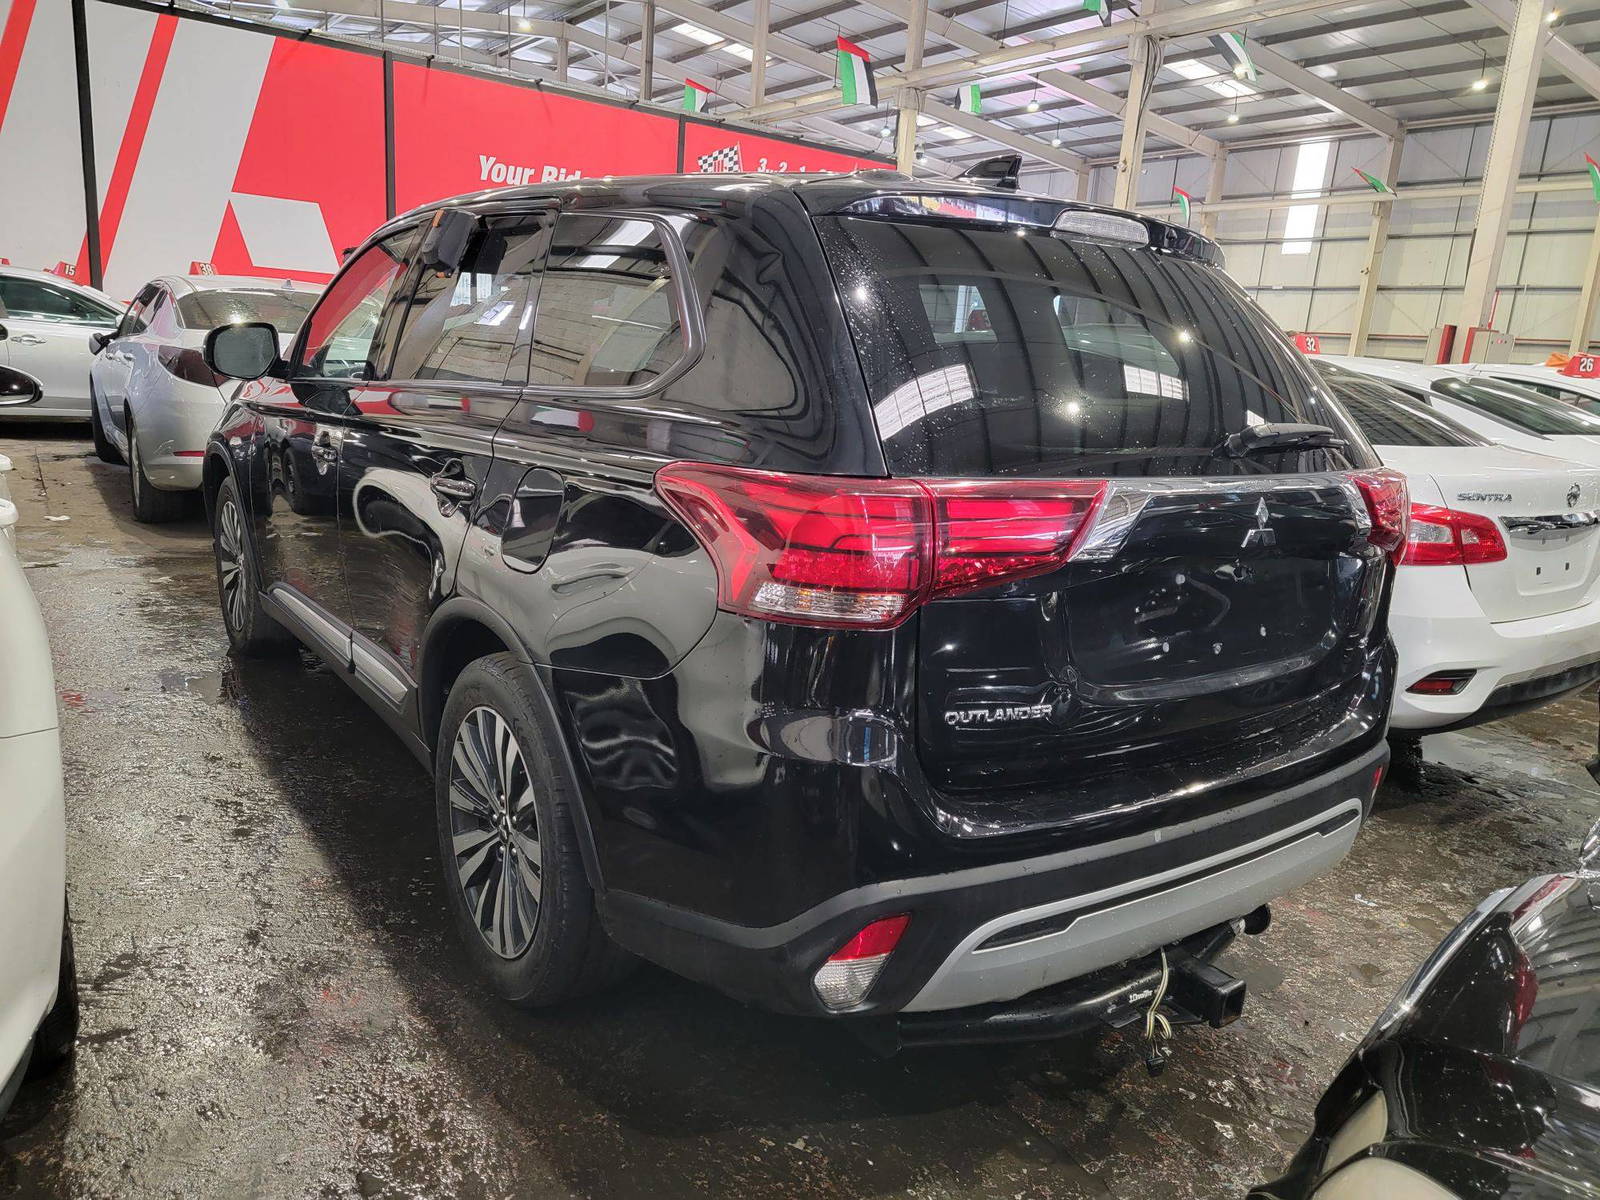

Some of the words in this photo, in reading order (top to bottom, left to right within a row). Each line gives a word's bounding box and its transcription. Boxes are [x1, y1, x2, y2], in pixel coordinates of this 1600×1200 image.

[479, 154, 535, 186] Your
[541, 165, 590, 184] Rid
[65, 264, 76, 276] 15
[1305, 336, 1317, 352] 32
[1580, 357, 1595, 372] 26
[1456, 492, 1513, 503] SENTRA
[944, 704, 1053, 725] OUTLANDER
